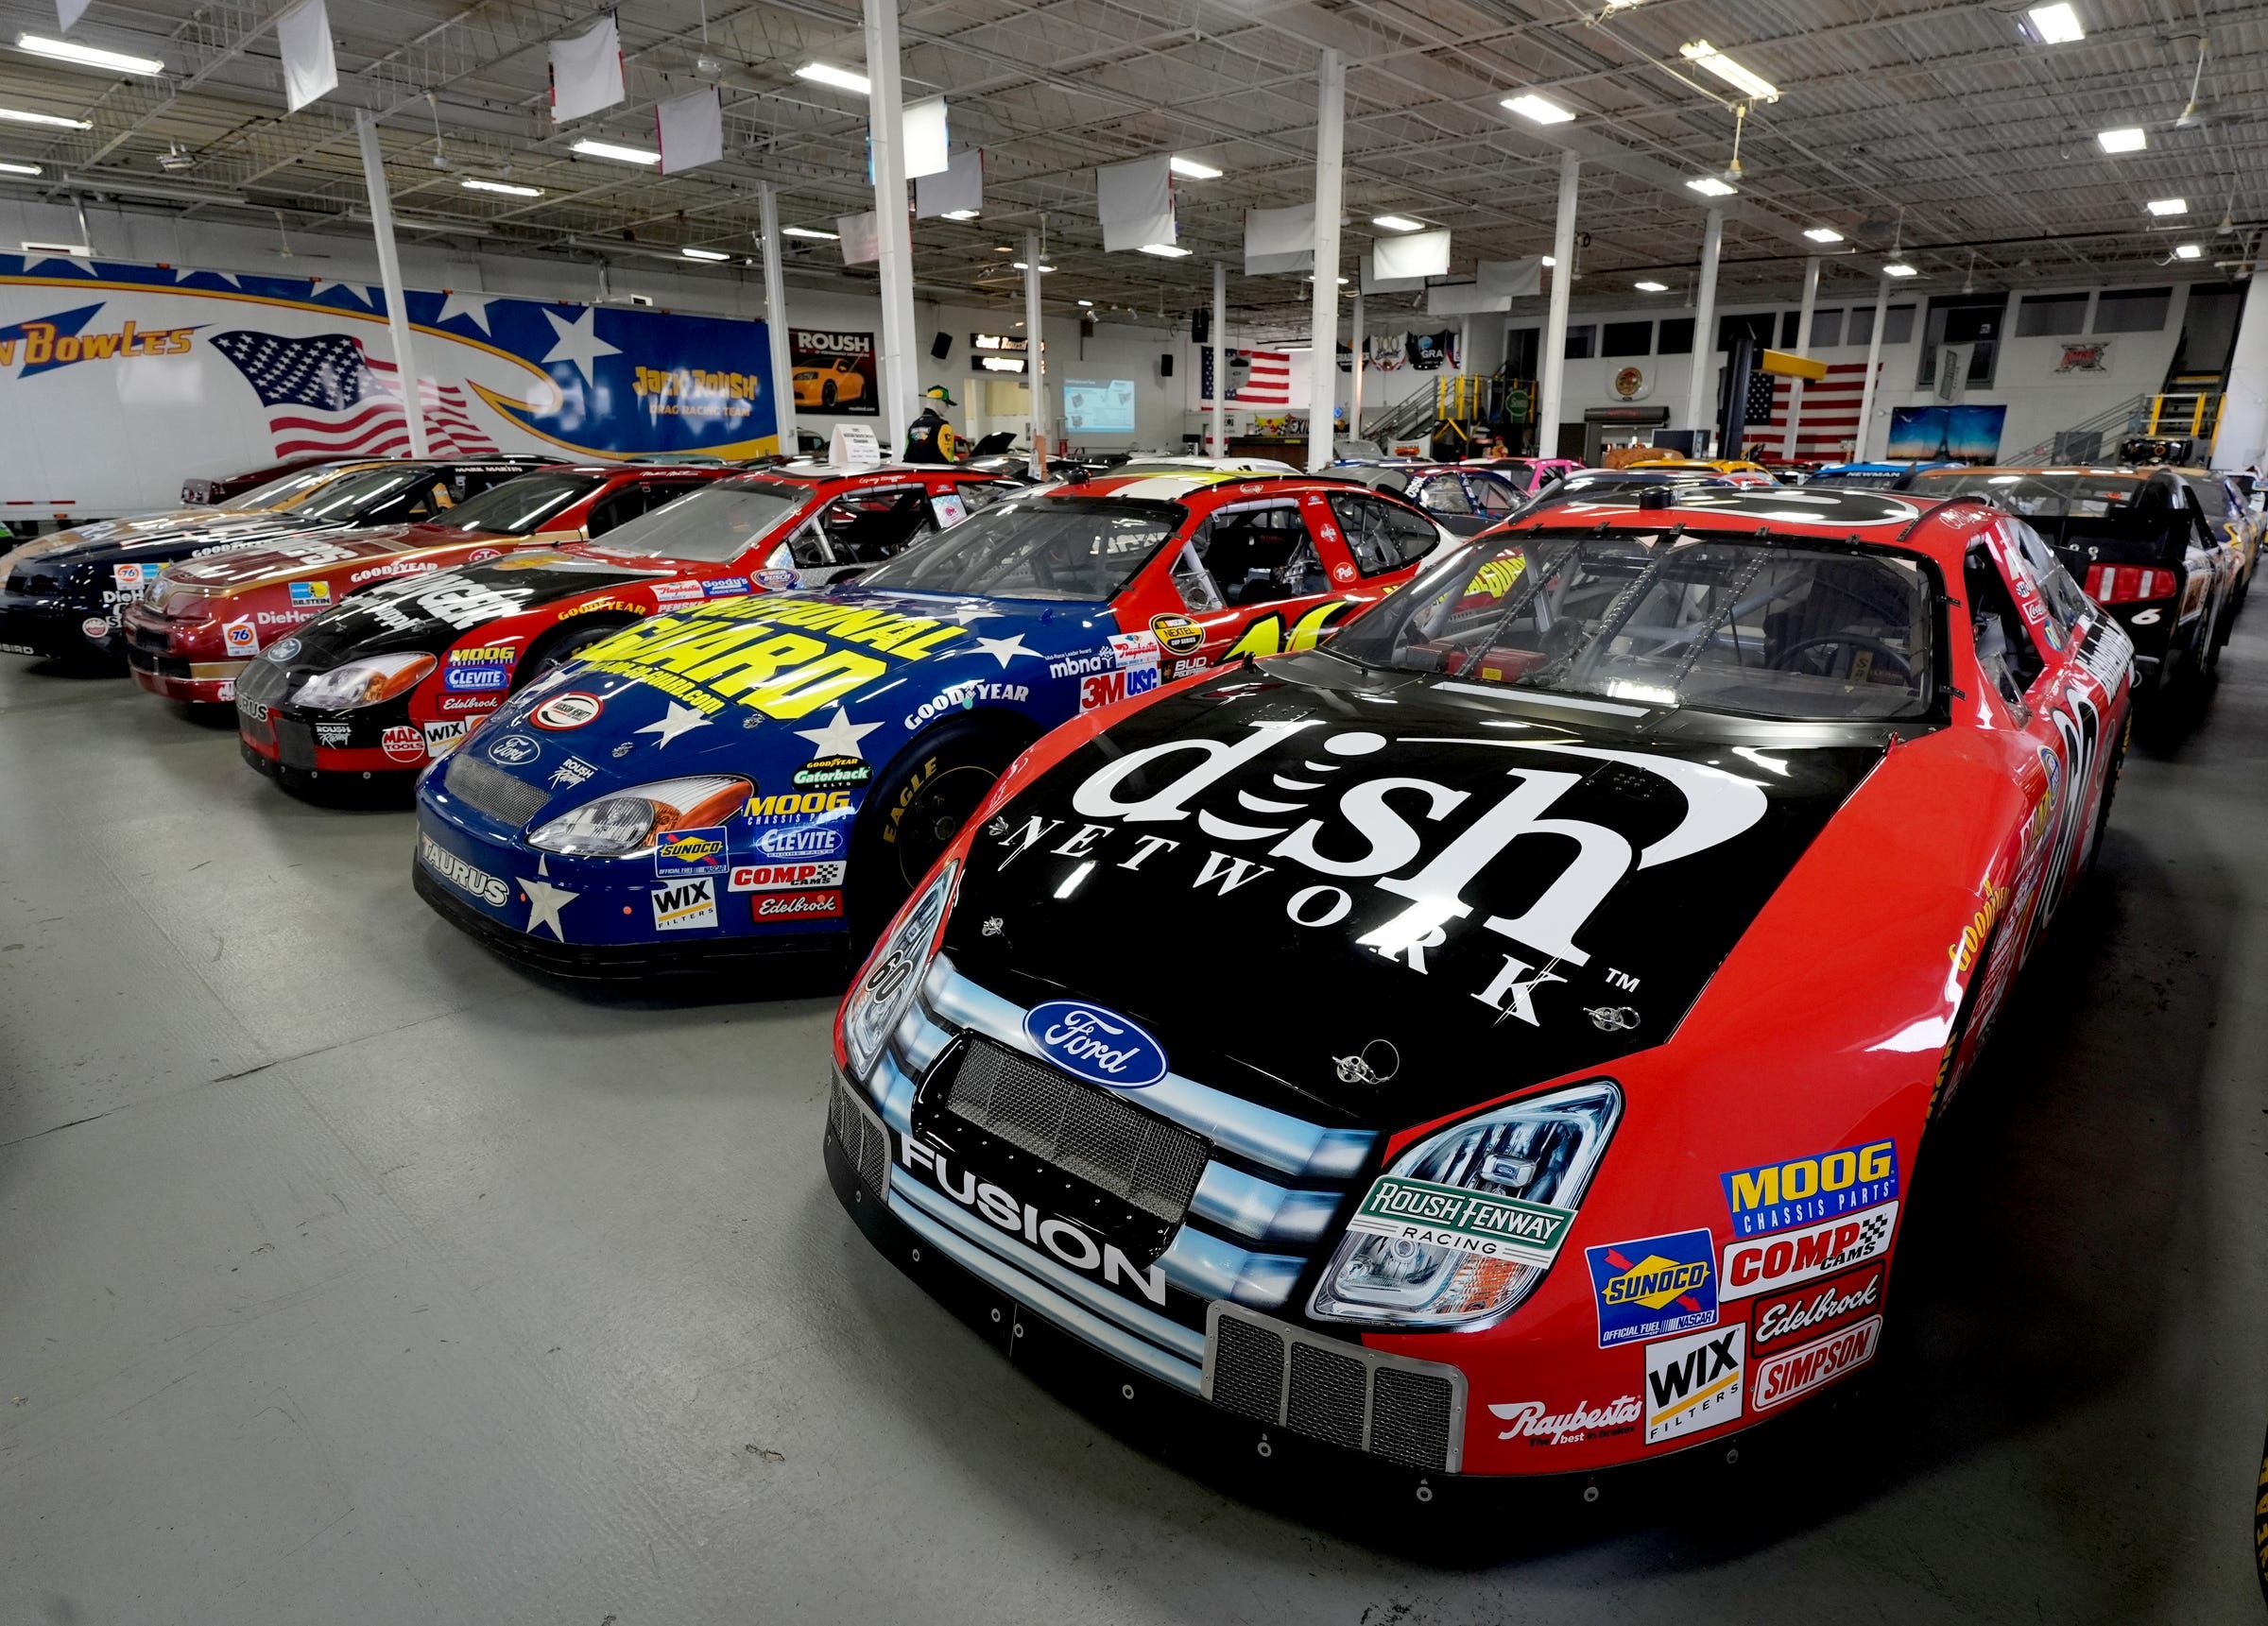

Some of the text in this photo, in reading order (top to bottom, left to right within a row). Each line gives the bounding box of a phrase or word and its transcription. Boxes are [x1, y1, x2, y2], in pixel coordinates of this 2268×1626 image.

[798, 332, 869, 352] ROUSH
[351, 558, 438, 583] GOODYEAR
[701, 577, 748, 588] Goody's
[102, 590, 146, 604] DieH
[558, 597, 646, 621] GOODYEAR
[232, 627, 249, 642] 76
[1163, 627, 1195, 638] NEXTEL
[450, 646, 516, 662] MOOG
[1175, 656, 1208, 672] BUD
[449, 669, 502, 685] CLEVITE
[571, 617, 888, 720] GUARD
[1049, 656, 1102, 679] mbna
[442, 695, 498, 710] Edelbrock
[1081, 671, 1125, 710] 3M
[235, 692, 269, 723] URUS
[903, 682, 1029, 731] GOODYEAR
[382, 726, 421, 744] MAC
[426, 721, 463, 743] WIX
[384, 742, 425, 750] TOOLS
[492, 736, 532, 762] Ford
[562, 758, 595, 779] ROUSH
[793, 766, 870, 783] Gatorback
[806, 757, 858, 768] GOODYEAR
[743, 791, 851, 817] MOOG
[883, 756, 937, 844] EAGLE
[747, 813, 801, 826] CHASSIS
[662, 842, 721, 856] SUNOCO
[761, 828, 836, 852] CLEVITE
[421, 831, 511, 908] TAURUS
[733, 864, 816, 886] COMP
[790, 878, 832, 886] CAMS
[653, 880, 712, 914] WIX
[759, 894, 836, 916] Edelbrock
[658, 907, 714, 929] FILTERS
[865, 949, 914, 1004] 60
[1044, 1009, 1140, 1074] Ford
[1730, 1140, 1893, 1214] MOOG
[1369, 1182, 1562, 1245] ROUSH FENWAY
[1744, 1181, 1890, 1234] CHASSIS PARTS
[900, 1134, 1167, 1307] FUSION
[1400, 1226, 1498, 1256] RACING
[1729, 1223, 1860, 1287] COMP
[1819, 1241, 1876, 1272] CAMS
[1609, 1263, 1705, 1301] SUNOCO
[1755, 1274, 1880, 1343] Edelbrock
[1603, 1310, 1714, 1342] OFFICIAL FUEL NASCAR
[1648, 1329, 1740, 1409] WIX
[1763, 1325, 1871, 1399] SIMPSON
[1487, 1395, 1642, 1446] Raybestos
[1650, 1382, 1739, 1440] FILTERS
[1559, 1432, 1586, 1445] best
